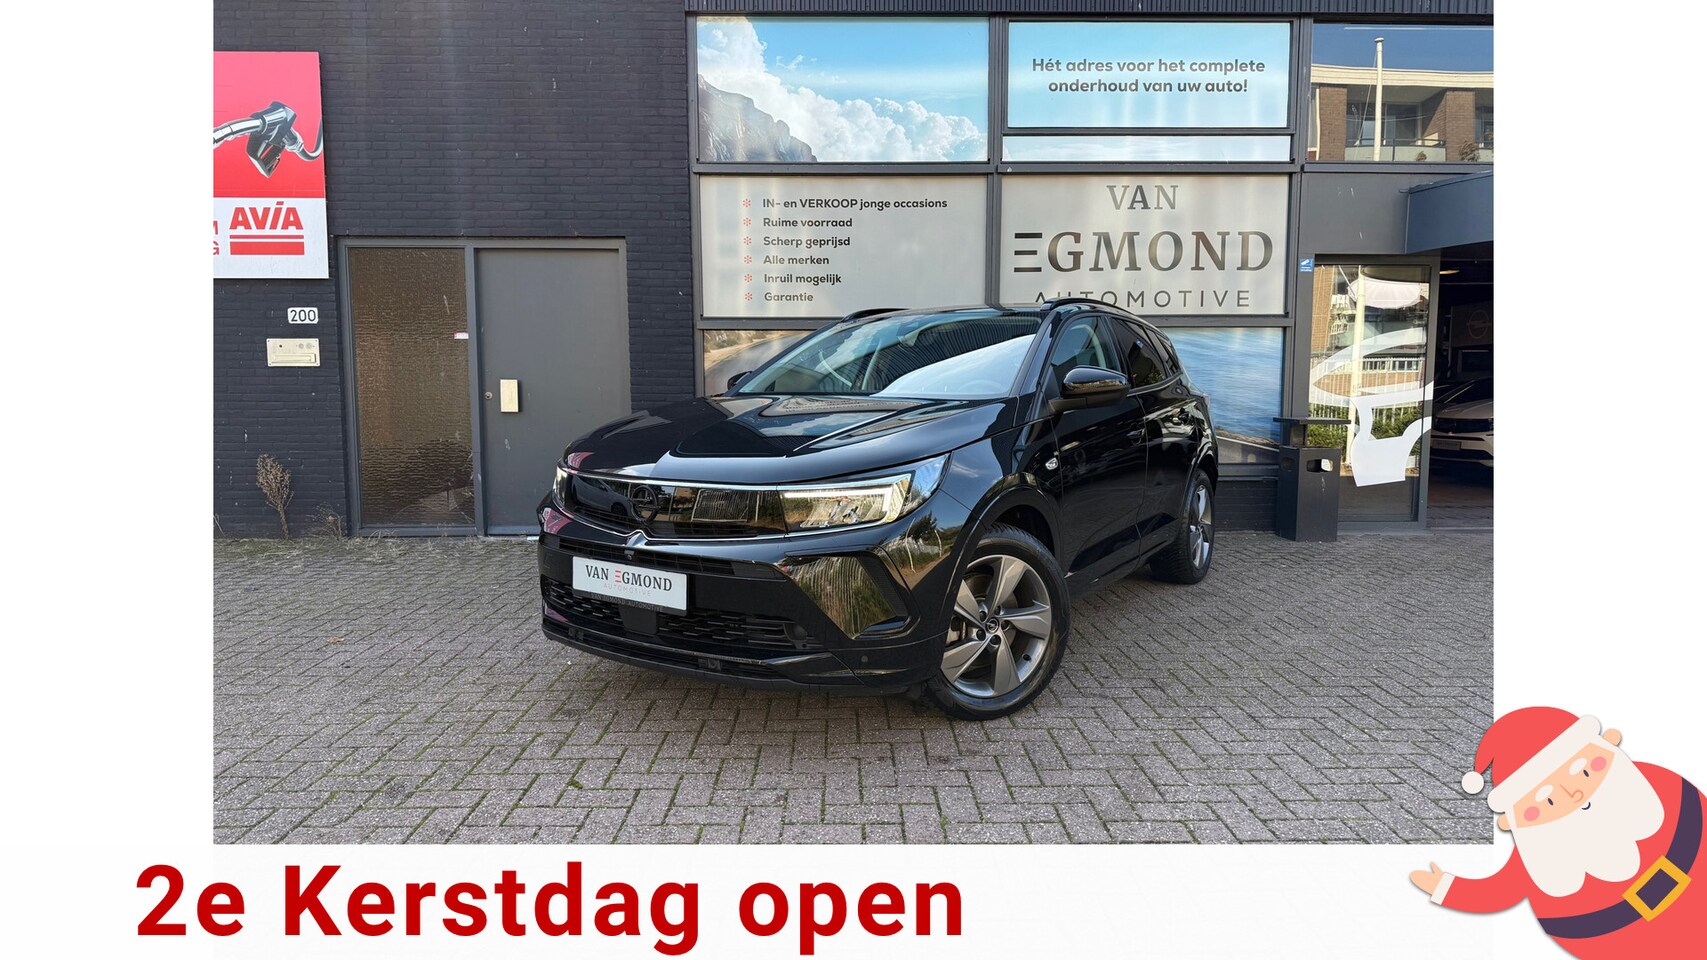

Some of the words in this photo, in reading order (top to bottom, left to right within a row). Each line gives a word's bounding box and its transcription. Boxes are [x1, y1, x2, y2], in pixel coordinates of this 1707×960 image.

[1032, 58, 1062, 72] Hét
[1066, 58, 1113, 72] adres
[1117, 61, 1154, 72] voor
[1158, 58, 1185, 72] het
[1189, 58, 1265, 75] complete
[1048, 79, 1139, 92] onderhoud
[1143, 82, 1173, 92] van
[1177, 82, 1201, 92] uw
[1204, 79, 1248, 92] auto!
[1106, 185, 1179, 210] VAN
[762, 199, 781, 208] IN-
[799, 199, 858, 208] VERKOOP
[859, 199, 891, 211] jonge
[893, 199, 948, 208] occasions
[763, 218, 798, 227] Ruime
[800, 217, 853, 227] voorraad
[763, 237, 803, 248] Scherp
[805, 237, 850, 249] geprijsd
[1013, 231, 1273, 273] EGMOND
[763, 255, 785, 264] Alle
[787, 255, 830, 264] merken
[764, 274, 793, 283] Inruil
[795, 274, 842, 285] mogelijk
[764, 292, 814, 301] Garantie
[290, 309, 317, 322] 200
[585, 565, 609, 580] VAN
[614, 569, 672, 591] EGMOND
[603, 583, 651, 597] AUTOMOTIVE
